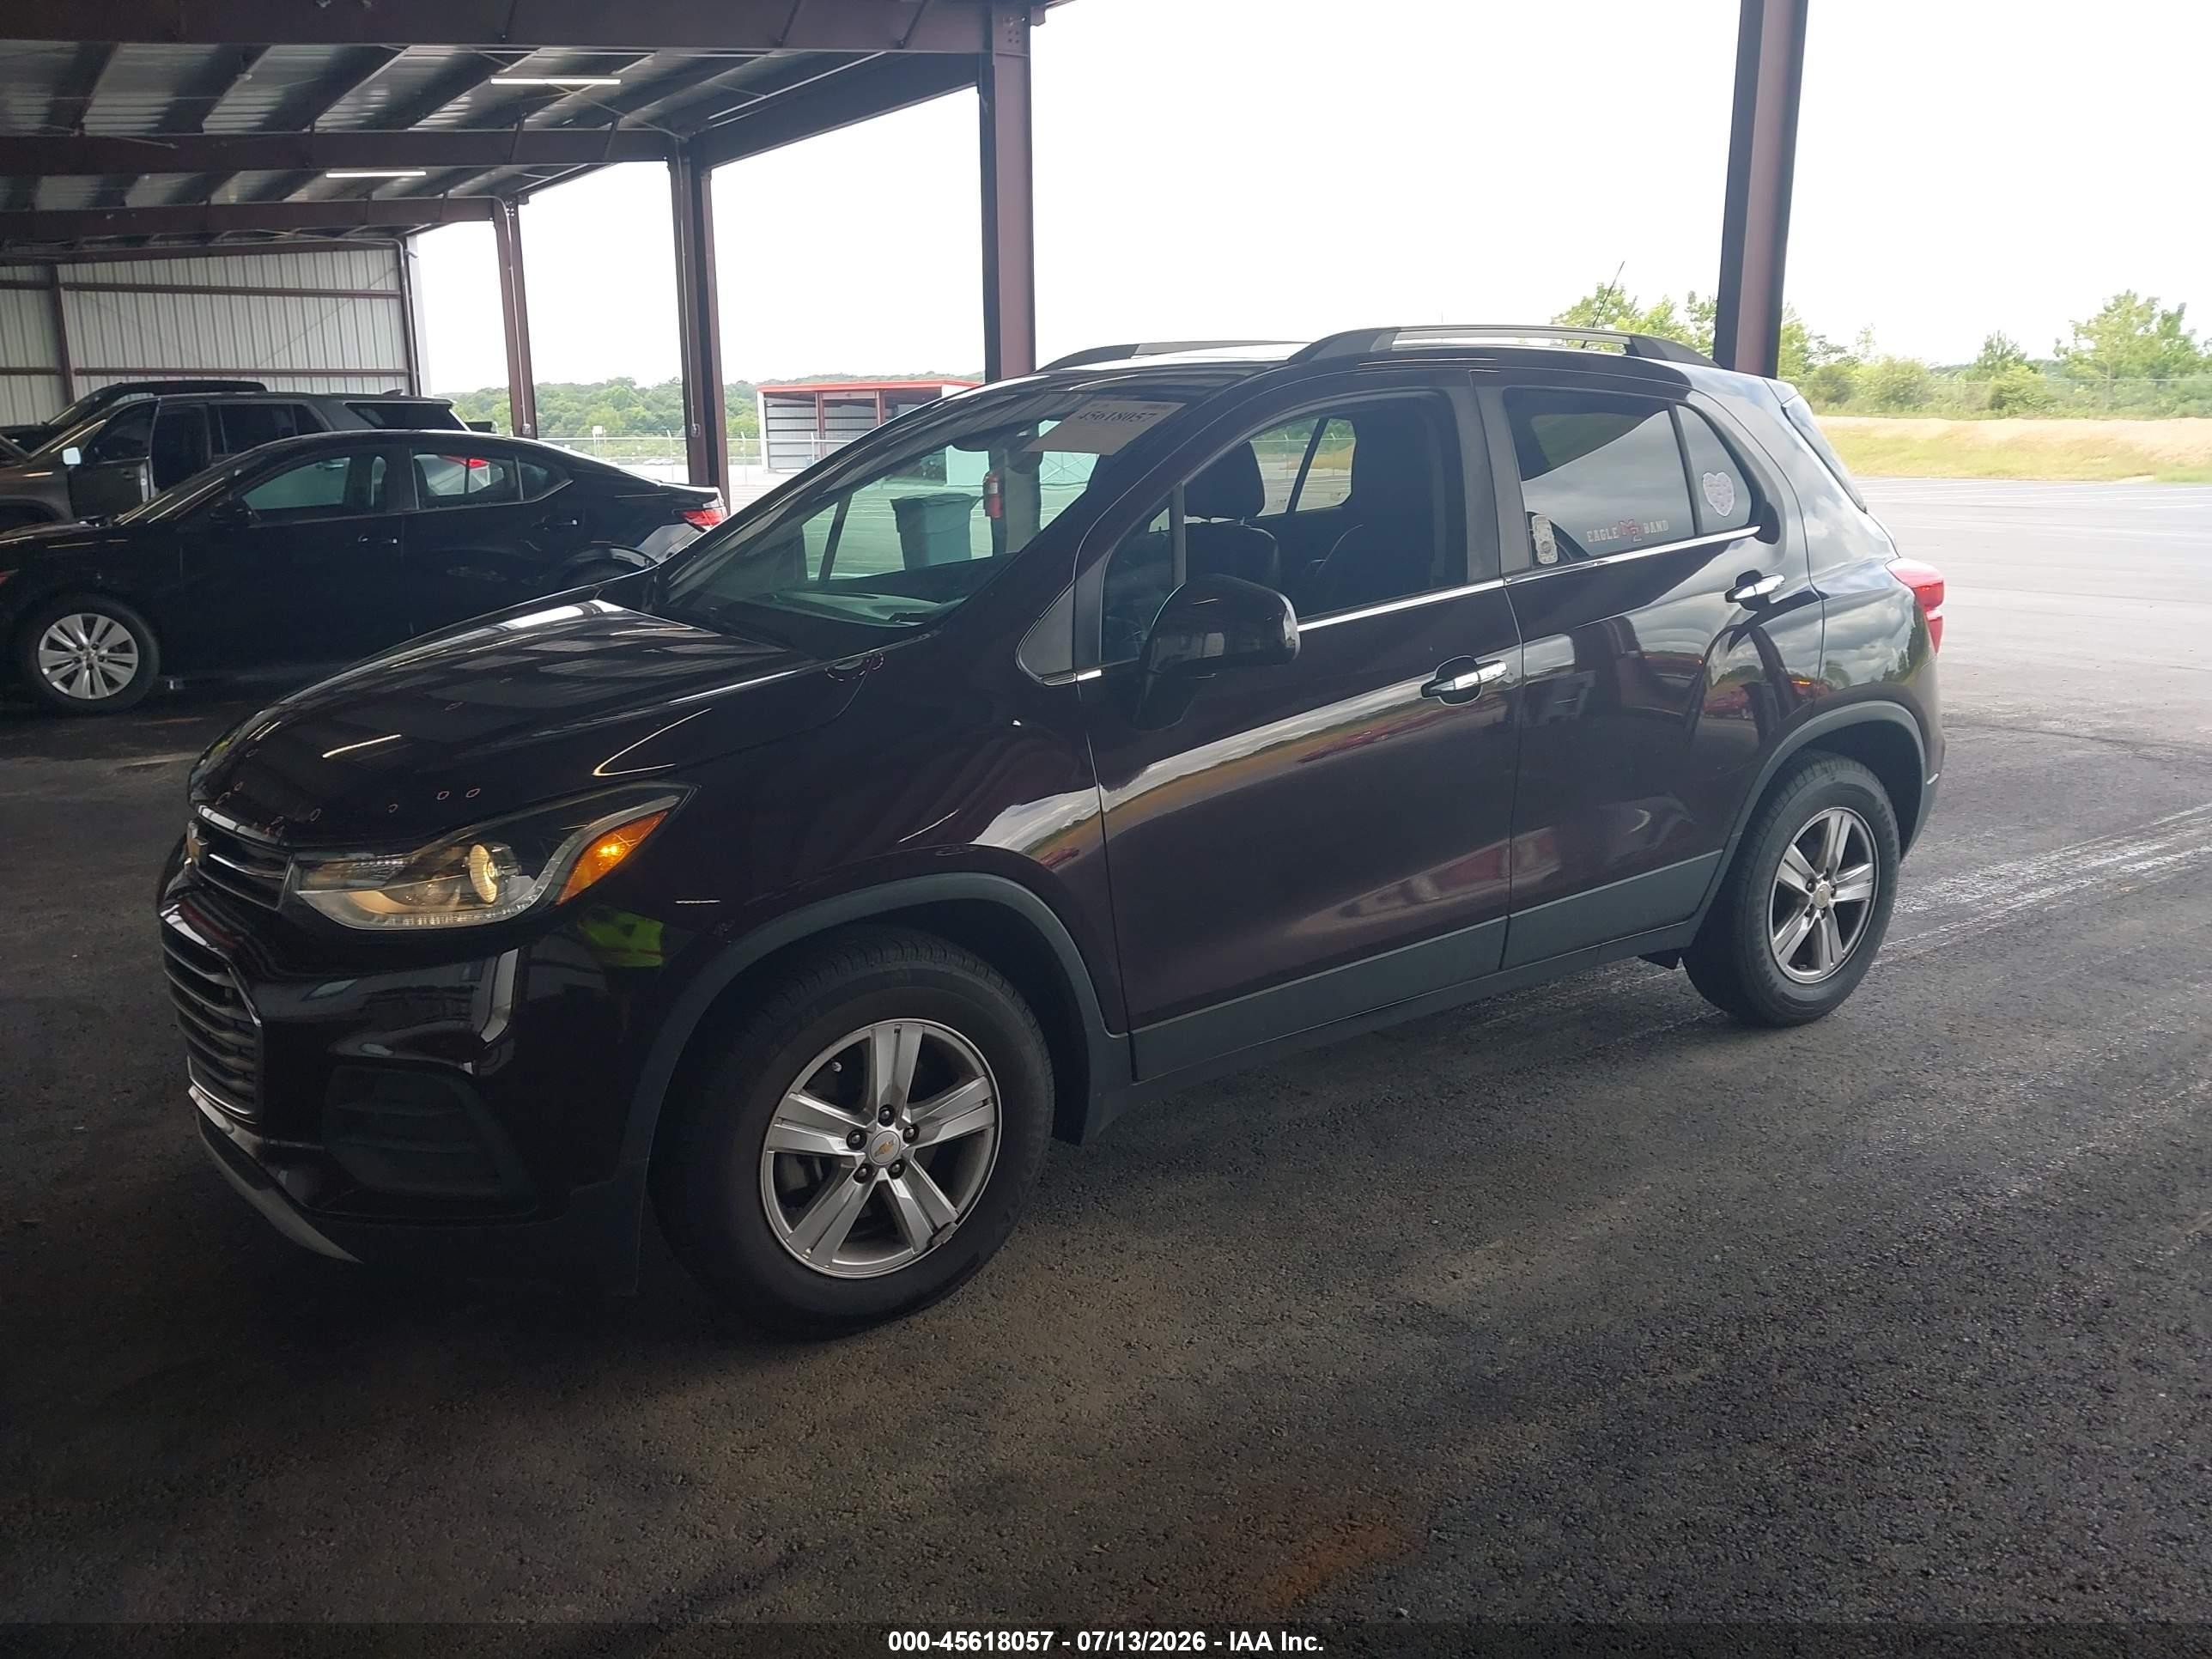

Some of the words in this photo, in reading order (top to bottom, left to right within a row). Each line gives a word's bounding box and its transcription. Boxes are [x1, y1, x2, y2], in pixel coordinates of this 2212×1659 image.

[1078, 410, 1158, 422] 45618057
[1586, 526, 1620, 543] EAGLE
[1643, 520, 1669, 534] BAND
